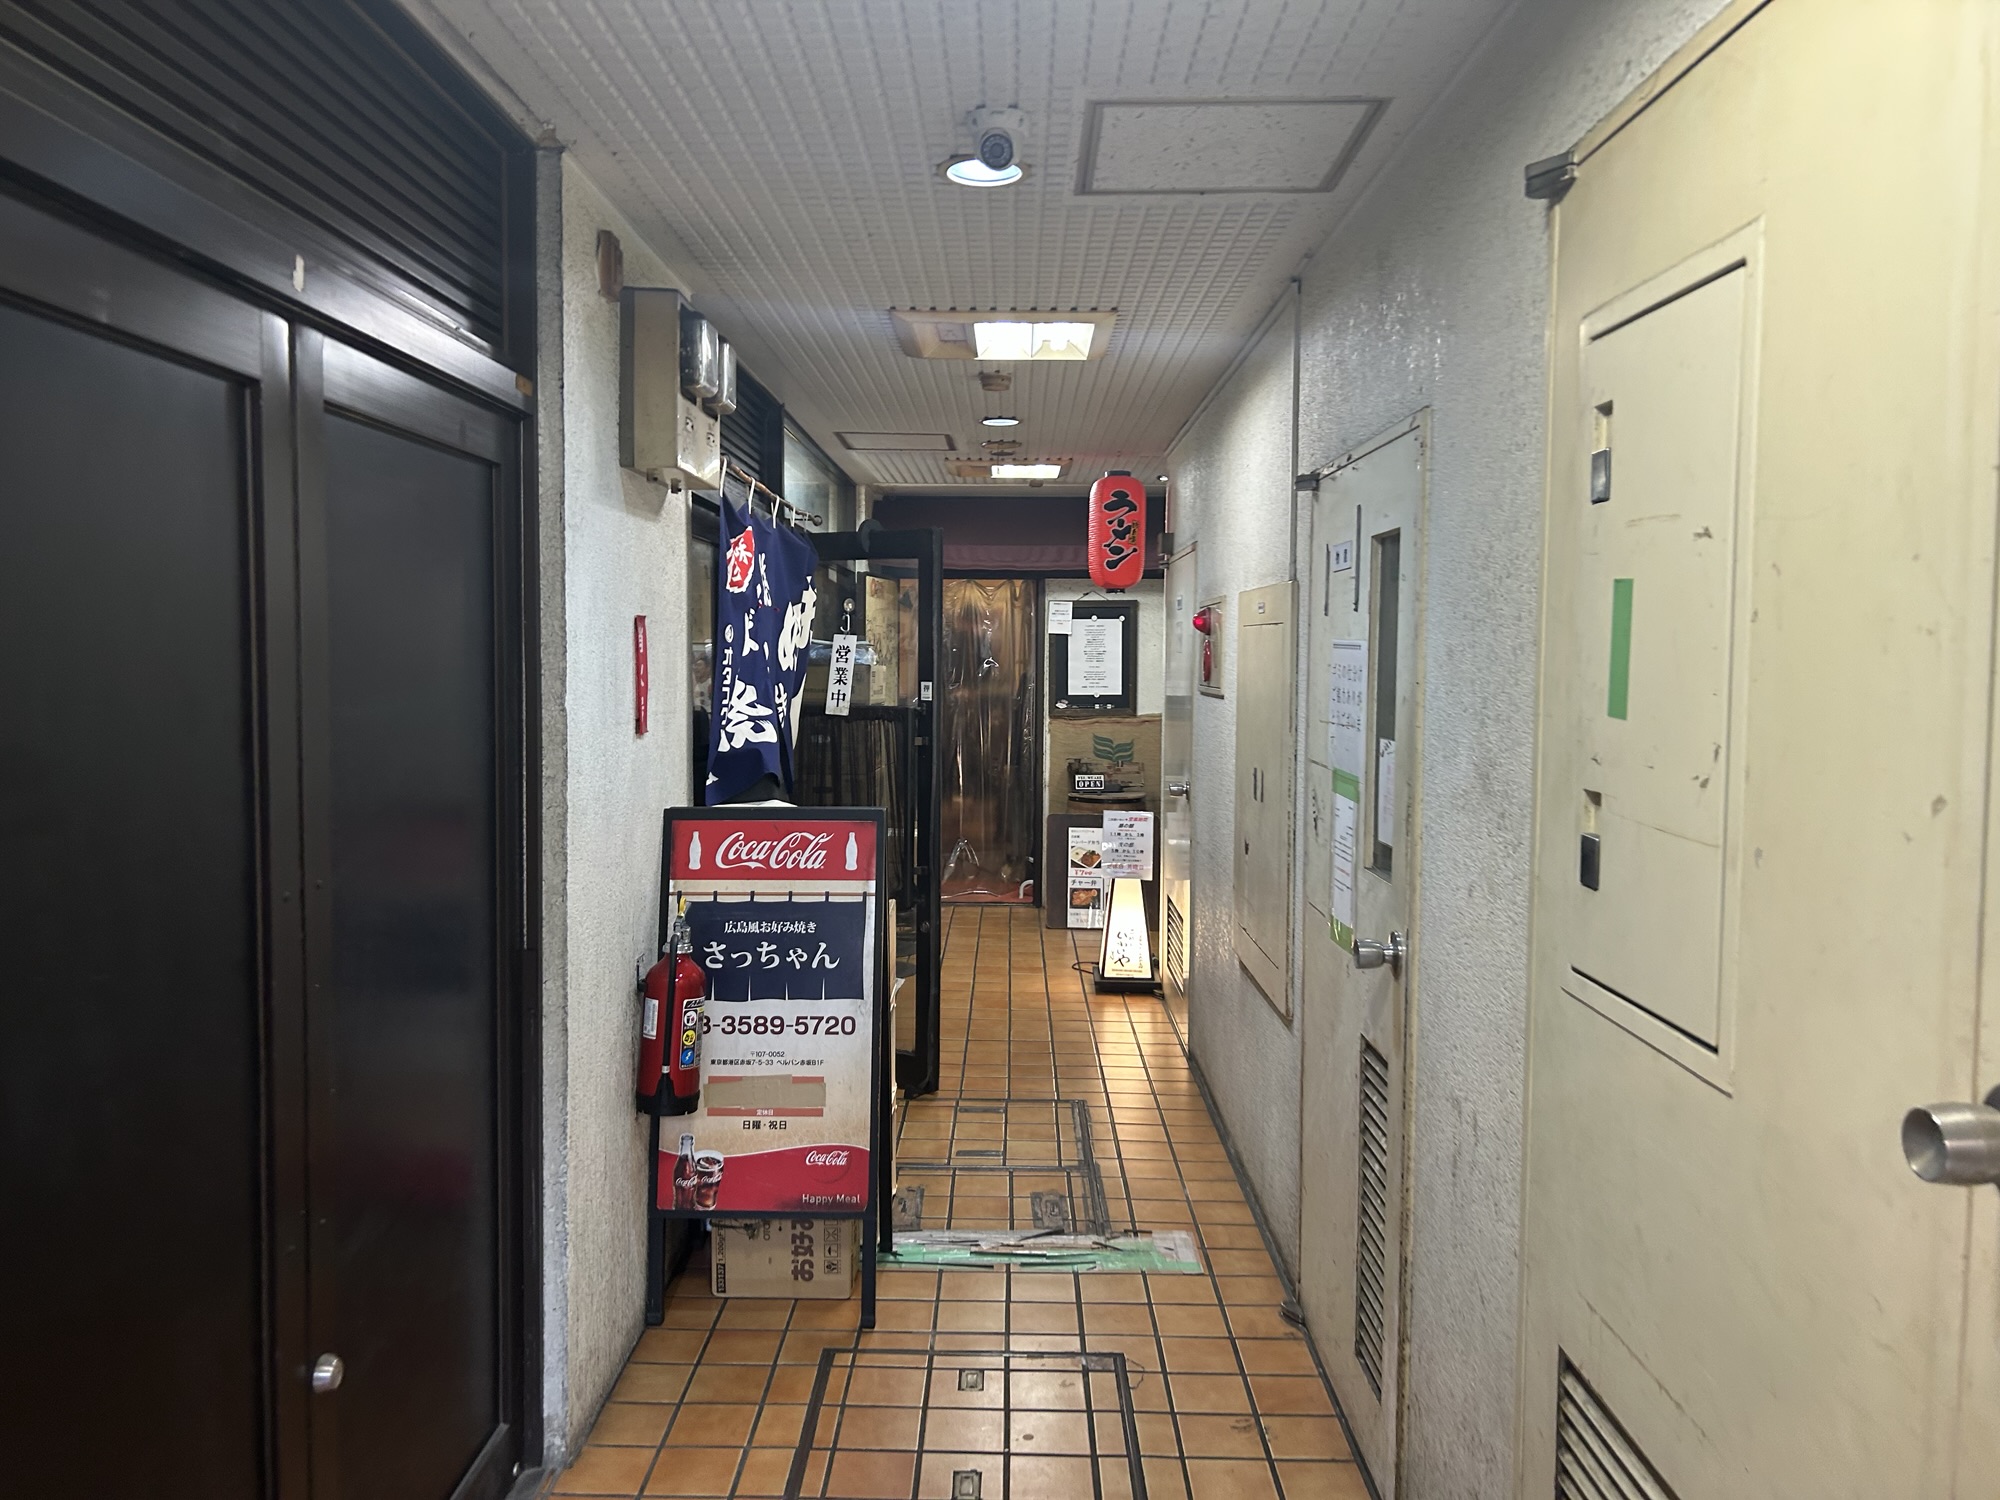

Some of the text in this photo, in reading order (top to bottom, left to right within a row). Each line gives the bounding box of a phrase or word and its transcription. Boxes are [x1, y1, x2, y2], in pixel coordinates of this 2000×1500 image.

[1102, 489, 1138, 571] ラーメン
[830, 644, 852, 708] 営業中
[1078, 780, 1101, 788] OPEN
[715, 831, 835, 869] Coca-Cola
[724, 920, 817, 934] 広島風お好み焼き
[703, 941, 841, 970] さっちゃん
[805, 1150, 850, 1167] Coca-Cola
[802, 1193, 861, 1206] Happy Meal
